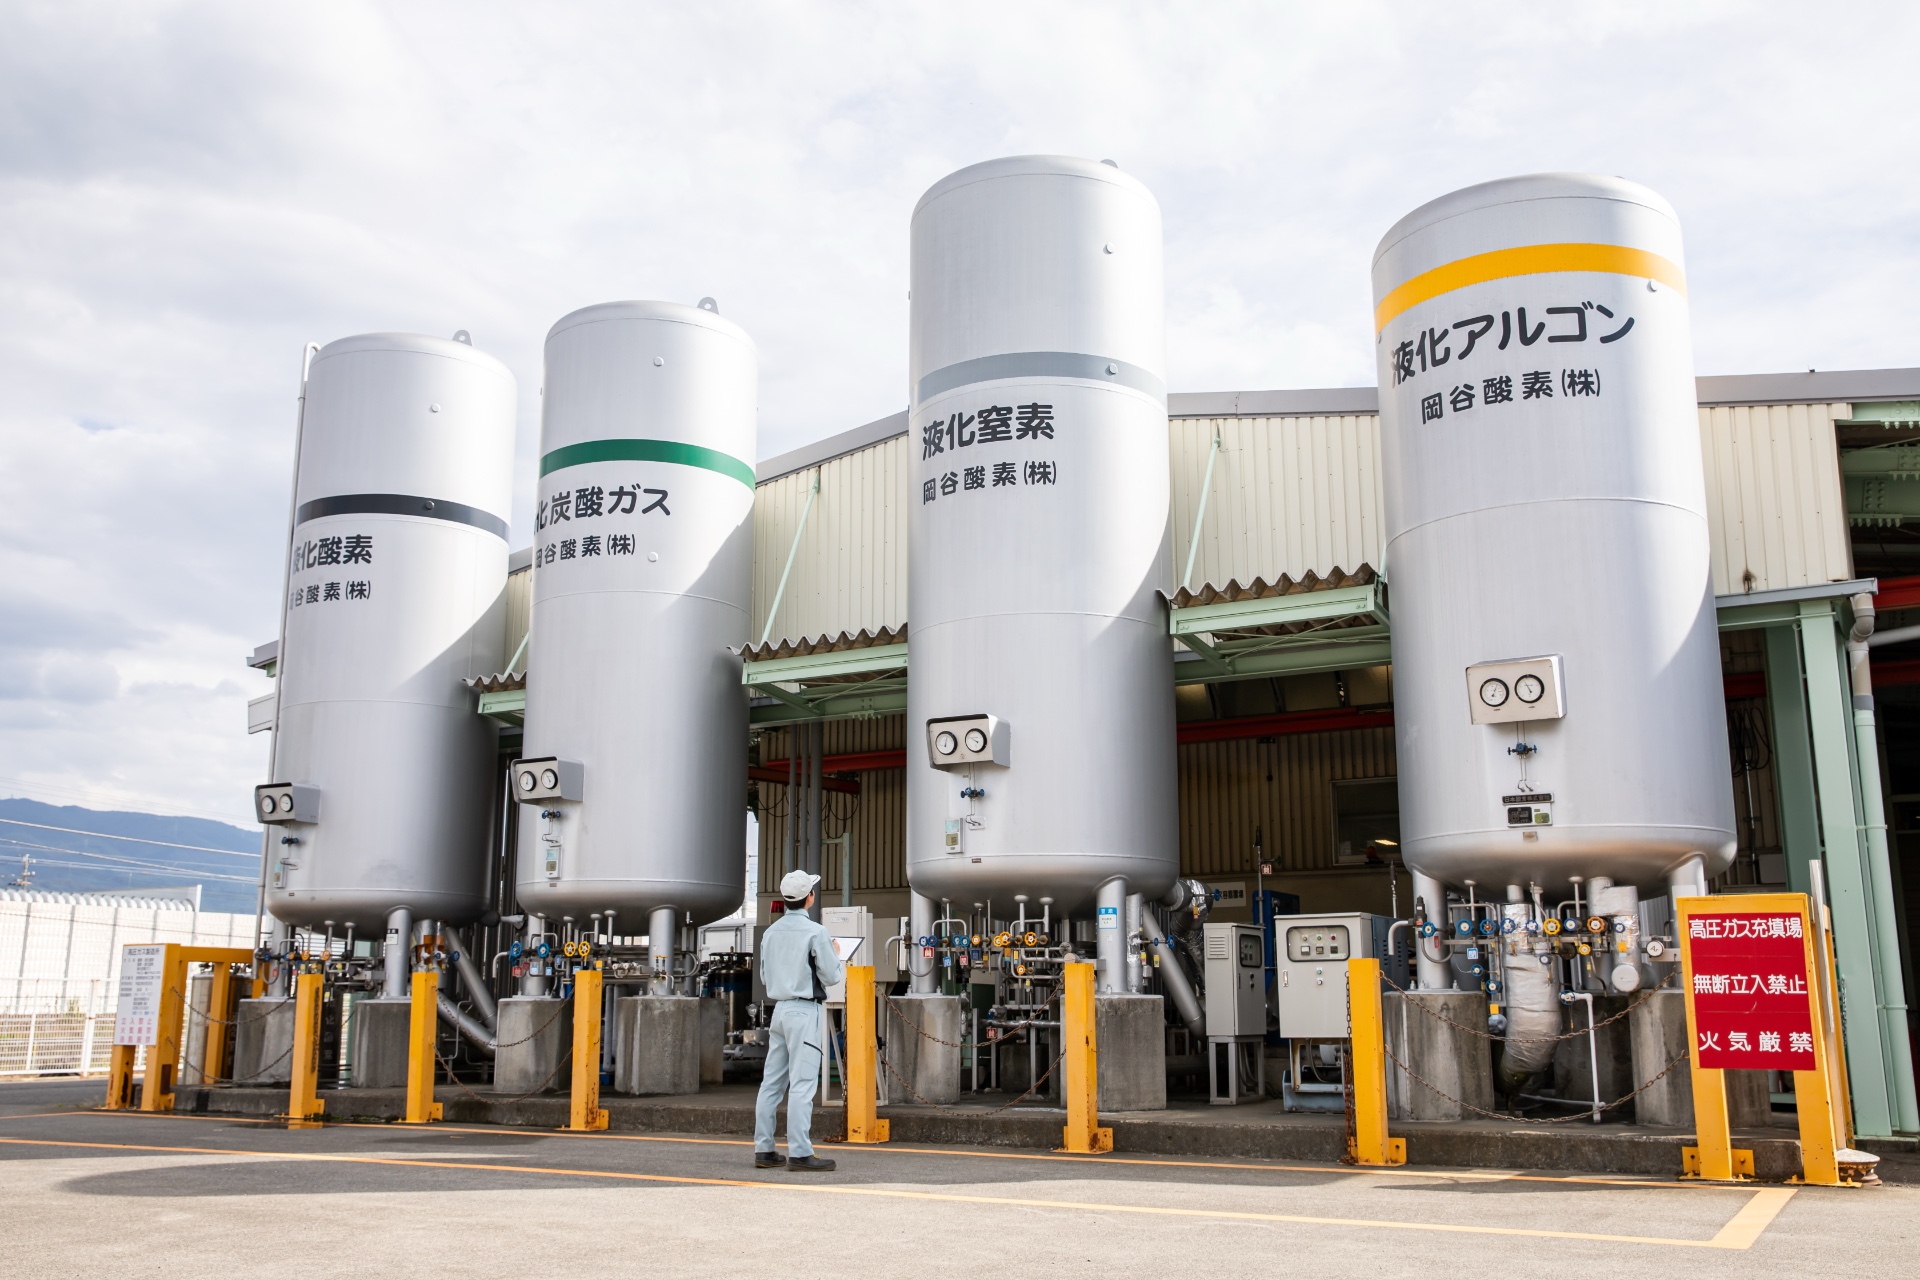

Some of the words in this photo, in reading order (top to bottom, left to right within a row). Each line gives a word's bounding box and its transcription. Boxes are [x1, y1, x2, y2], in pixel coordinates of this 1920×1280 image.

[1391, 301, 1635, 389] 液化アルゴン
[1422, 369, 1601, 424] 岡谷酸素(株)
[923, 402, 1055, 461] 液化窒素
[923, 461, 1057, 505] 岡谷酸素(株)
[534, 483, 671, 535] 化炭酸ガス
[1689, 917, 1803, 939] 高圧ガス充填場
[1693, 974, 1808, 995] 無断立入禁止
[1699, 1031, 1813, 1053] 火気厳禁
